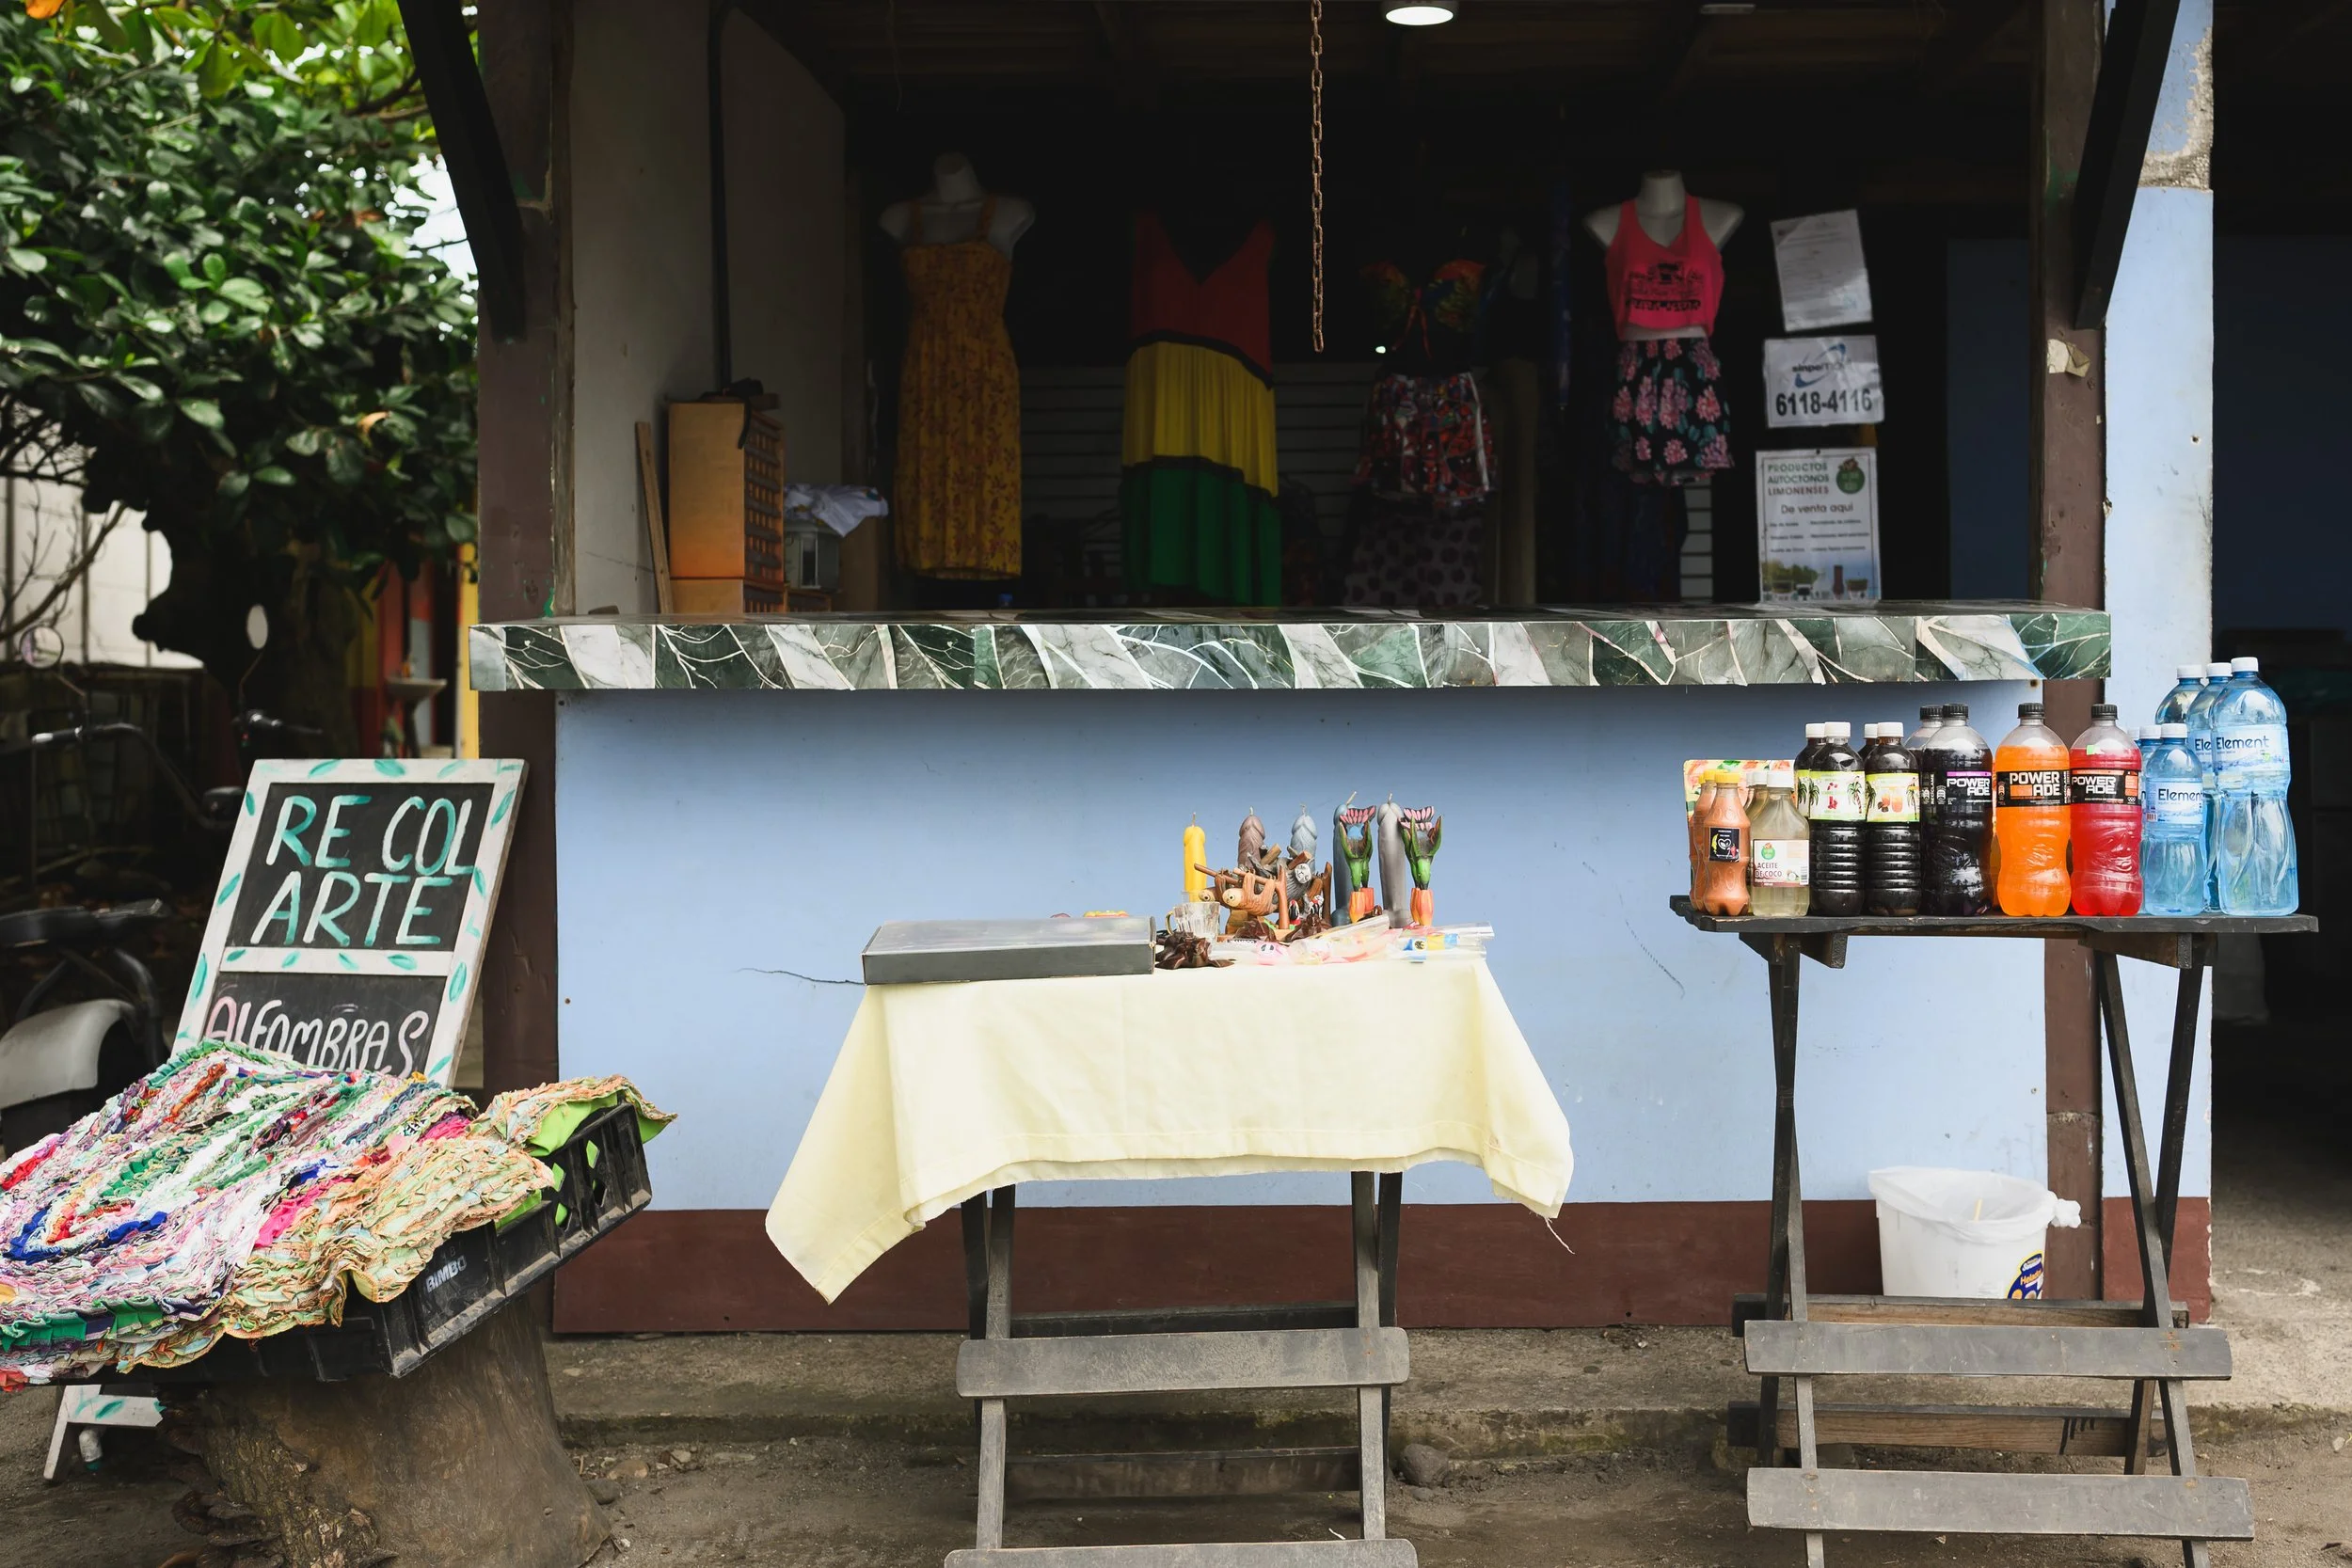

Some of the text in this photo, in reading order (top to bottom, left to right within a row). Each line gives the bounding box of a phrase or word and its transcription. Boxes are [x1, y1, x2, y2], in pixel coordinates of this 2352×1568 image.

[1775, 388, 1872, 417] 6118-4116
[1768, 462, 1828, 472] PRODUCTOS
[1768, 485, 1830, 497] LIMONENSES
[1781, 504, 1795, 515] De
[1798, 503, 1827, 514] venta
[2216, 735, 2270, 752] Element
[1947, 778, 1991, 787] POWER
[2009, 771, 2060, 784] POWER
[2072, 776, 2117, 785] POWER
[1967, 786, 1991, 797] ADE
[2033, 784, 2060, 797] ADE
[2086, 785, 2117, 795] ADE
[265, 795, 474, 876] RE COL
[249, 871, 453, 947] ARTE
[425, 1255, 468, 1293] BIMBO
